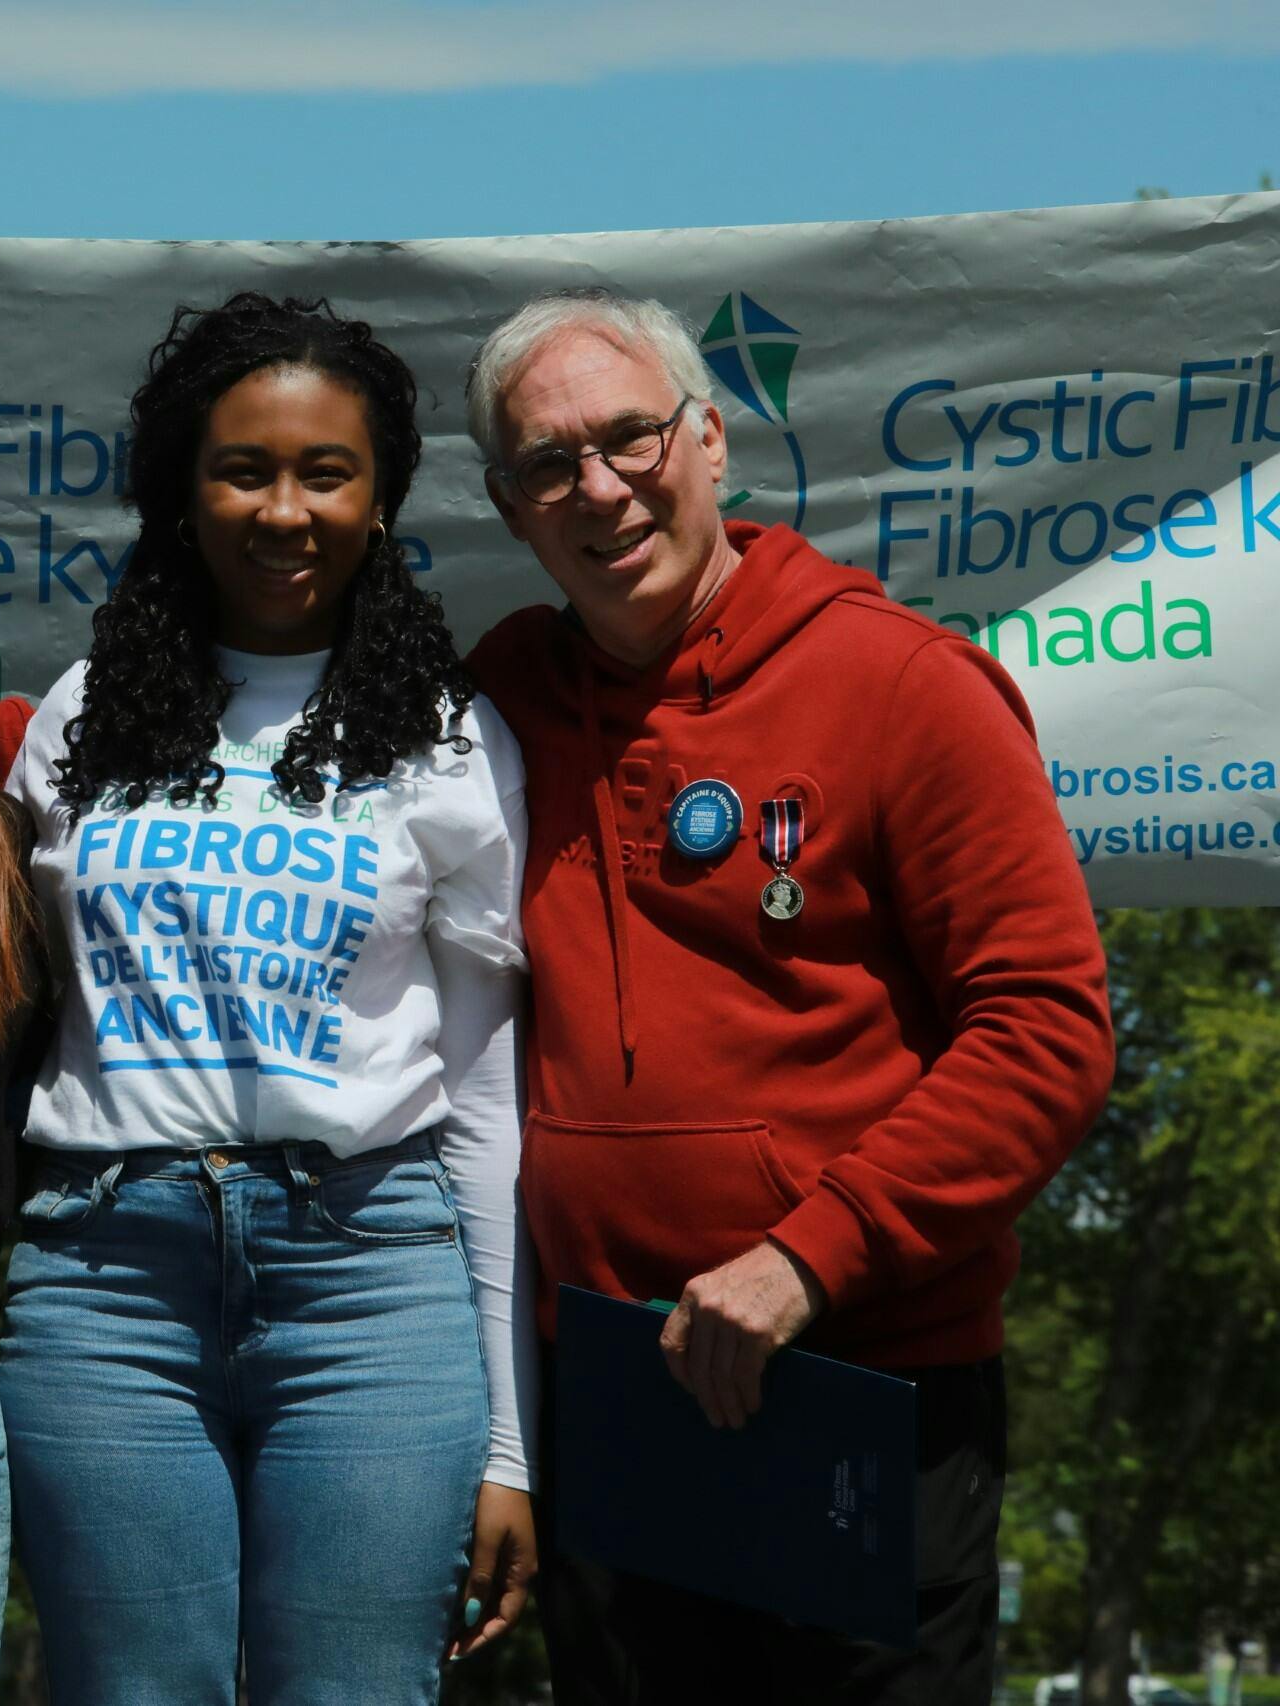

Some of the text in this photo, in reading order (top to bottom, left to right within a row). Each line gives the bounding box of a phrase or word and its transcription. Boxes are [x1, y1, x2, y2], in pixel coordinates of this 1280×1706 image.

[882, 368, 1155, 472] Cystic
[876, 485, 1218, 582] Fibrose
[899, 580, 1213, 667] anada
[209, 741, 286, 763] ARCHE
[676, 789, 711, 818] CAPITAINE
[76, 818, 380, 899] FIBROSE
[75, 880, 375, 963] KYSTIQUE
[90, 944, 351, 1006] DE L'HISTOIRE
[95, 993, 343, 1064] ANCIENNE
